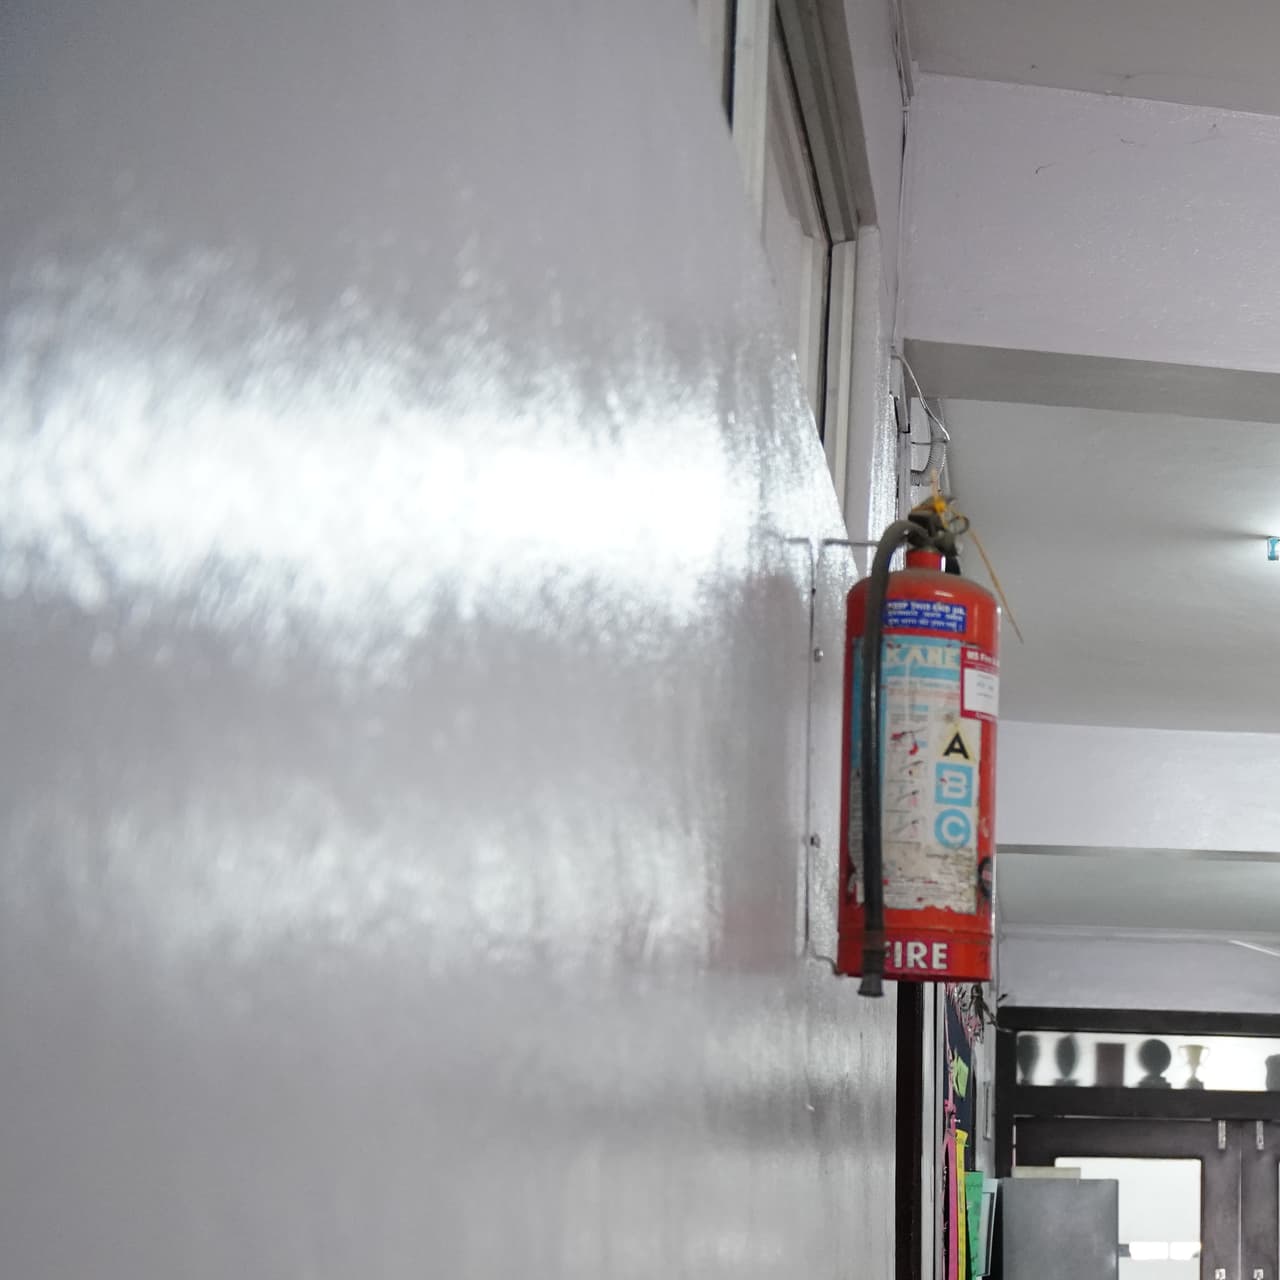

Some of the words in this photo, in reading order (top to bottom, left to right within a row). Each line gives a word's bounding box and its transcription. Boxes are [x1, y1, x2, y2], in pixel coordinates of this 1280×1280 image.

[943, 732, 970, 760] A
[943, 770, 967, 799] B
[941, 815, 966, 844] C
